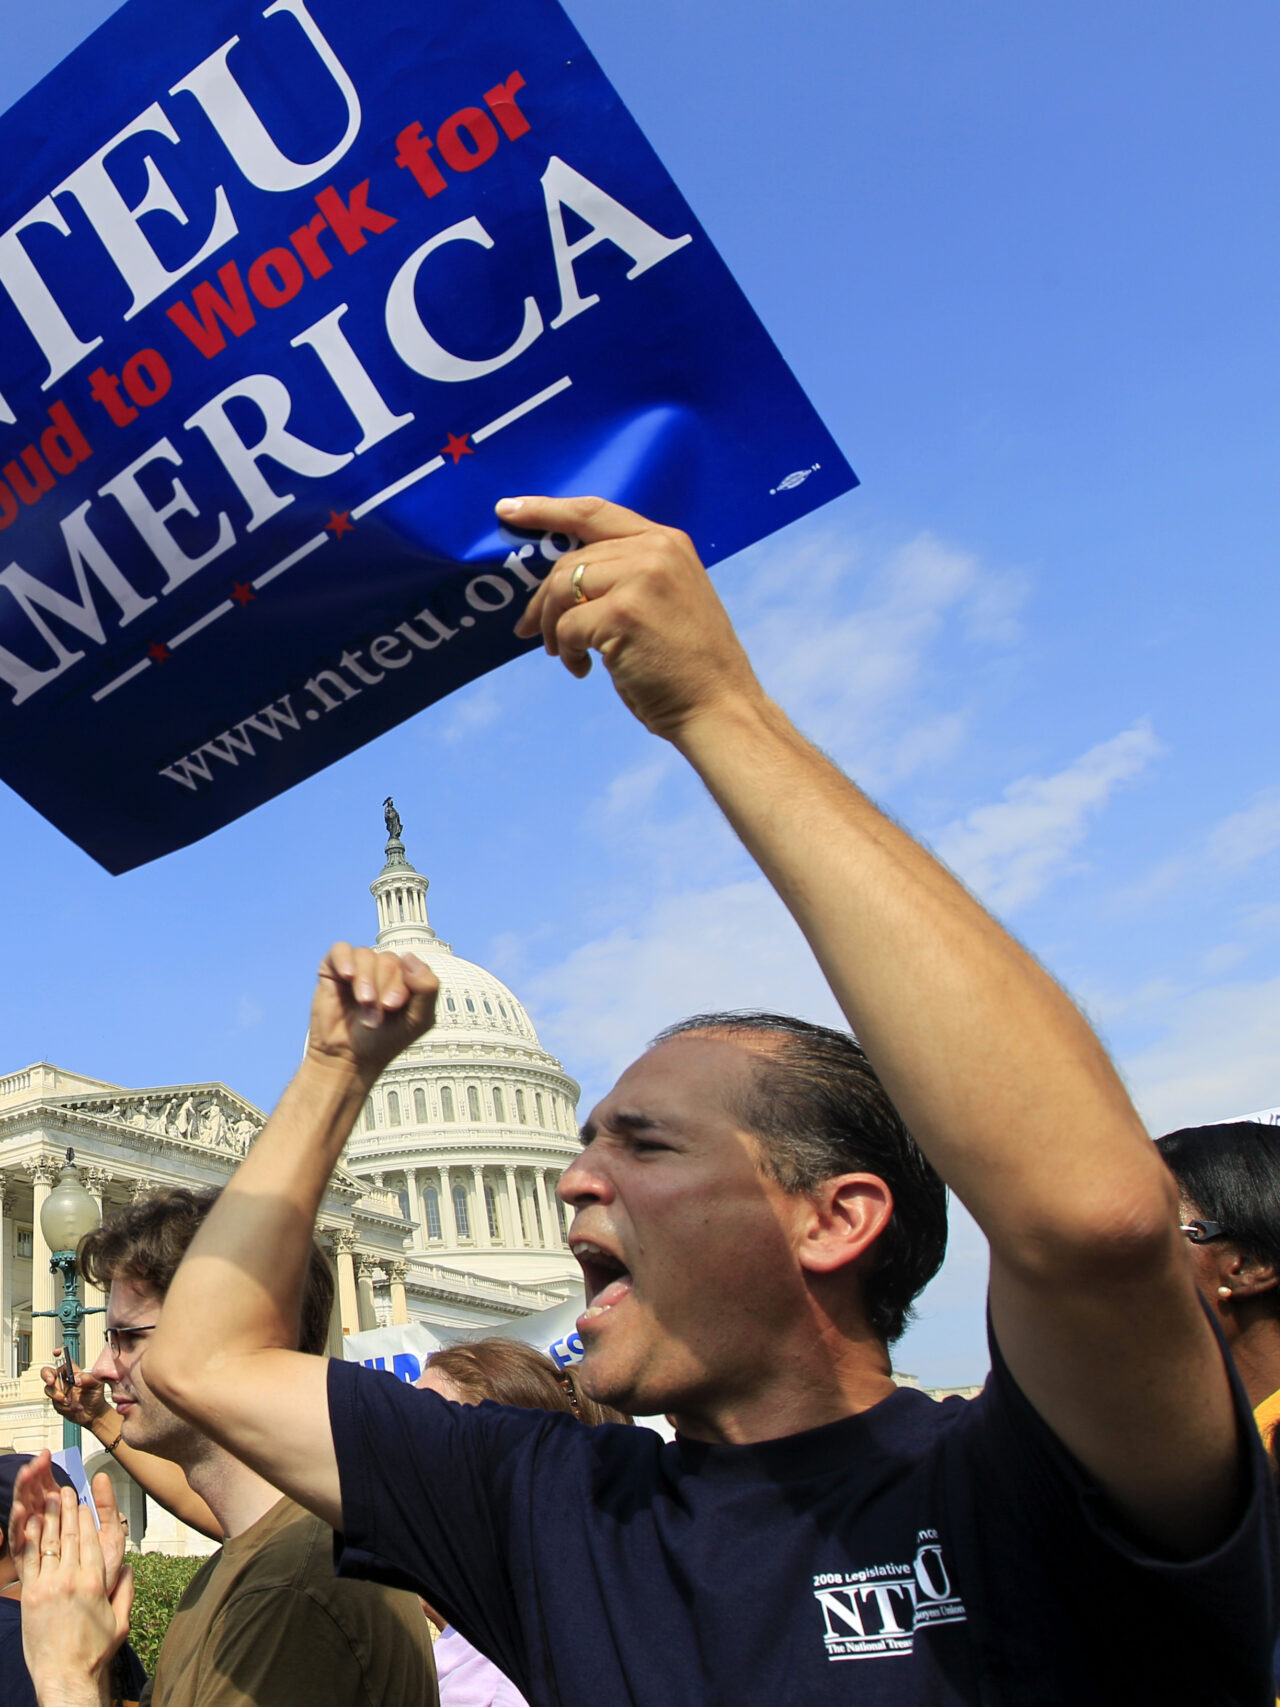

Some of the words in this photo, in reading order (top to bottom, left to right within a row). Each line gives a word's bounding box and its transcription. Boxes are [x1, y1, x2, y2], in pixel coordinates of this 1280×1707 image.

[88, 348, 172, 427] to
[166, 179, 398, 359] Work
[395, 70, 531, 199] for
[813, 1574, 843, 1587] 2008
[845, 1562, 911, 1584] Legislative
[825, 1642, 846, 1655] The
[845, 1639, 888, 1653] National
